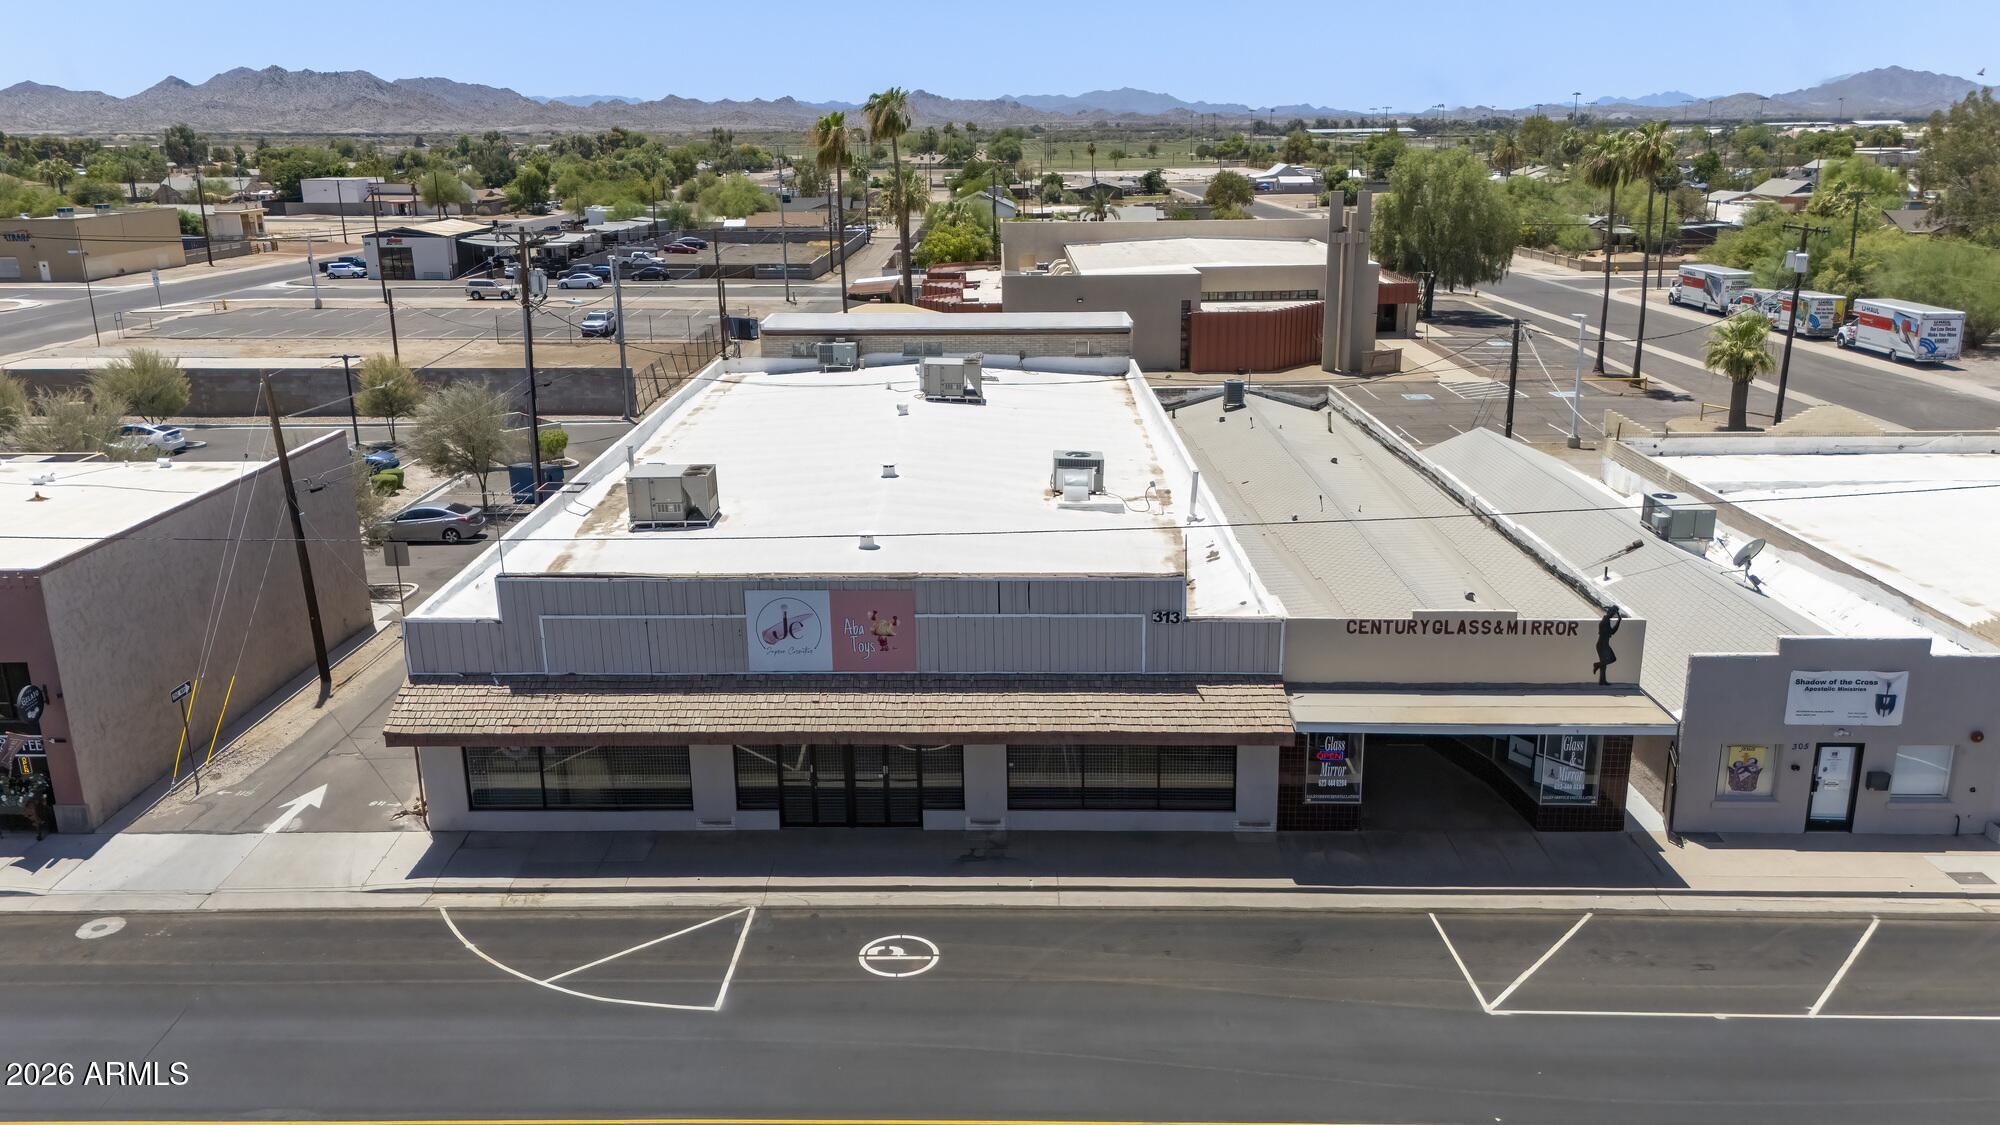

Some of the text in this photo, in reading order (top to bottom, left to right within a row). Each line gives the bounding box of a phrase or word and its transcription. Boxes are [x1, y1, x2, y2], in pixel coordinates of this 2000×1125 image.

[1153, 611, 1181, 624] 313
[844, 618, 865, 636] Aba
[851, 635, 876, 660] Toys
[1795, 678, 1879, 686] Shadow of the Cross
[1324, 736, 1346, 751] Glass
[1563, 736, 1584, 751] Glass
[1569, 752, 1576, 767] &
[1320, 761, 1347, 777] Mirror
